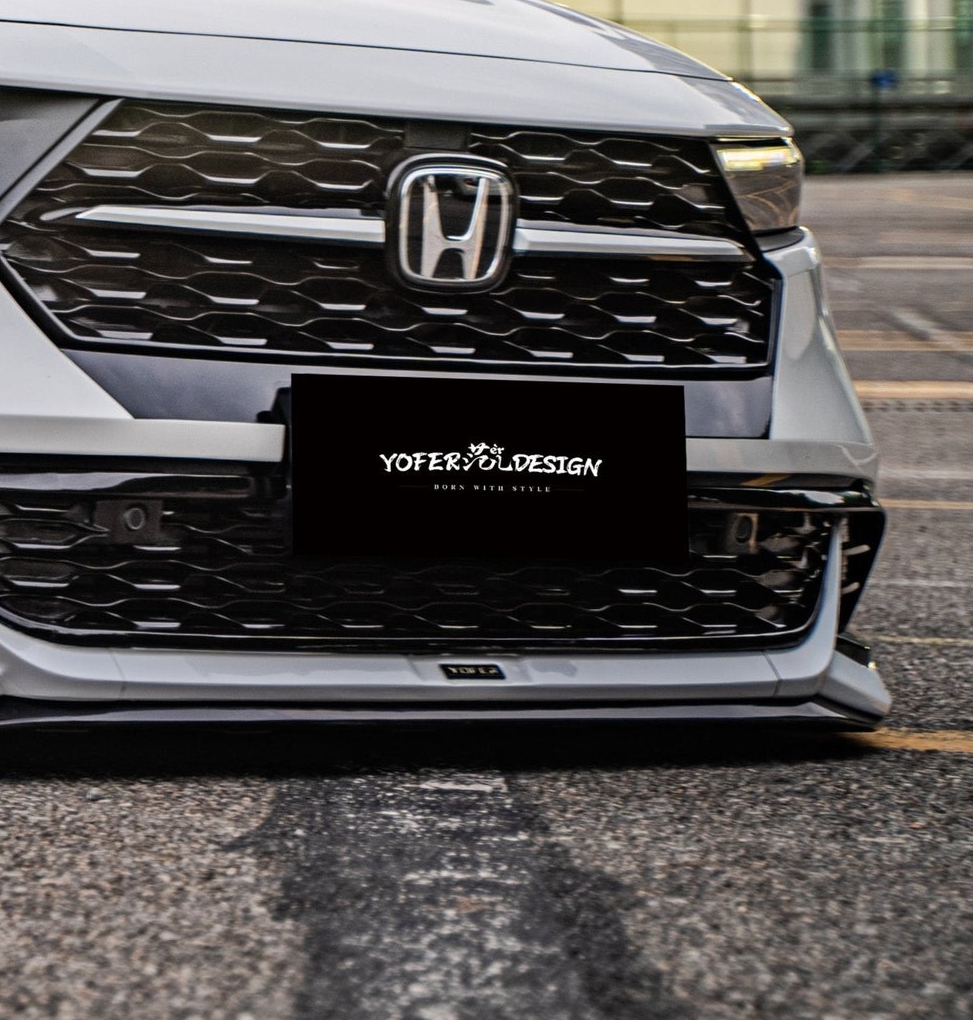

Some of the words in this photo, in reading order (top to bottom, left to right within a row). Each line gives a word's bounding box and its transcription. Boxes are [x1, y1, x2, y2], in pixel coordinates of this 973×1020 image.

[512, 453, 603, 477] DESIGN
[473, 484, 504, 492] WITH
[512, 485, 551, 493] STYLE
